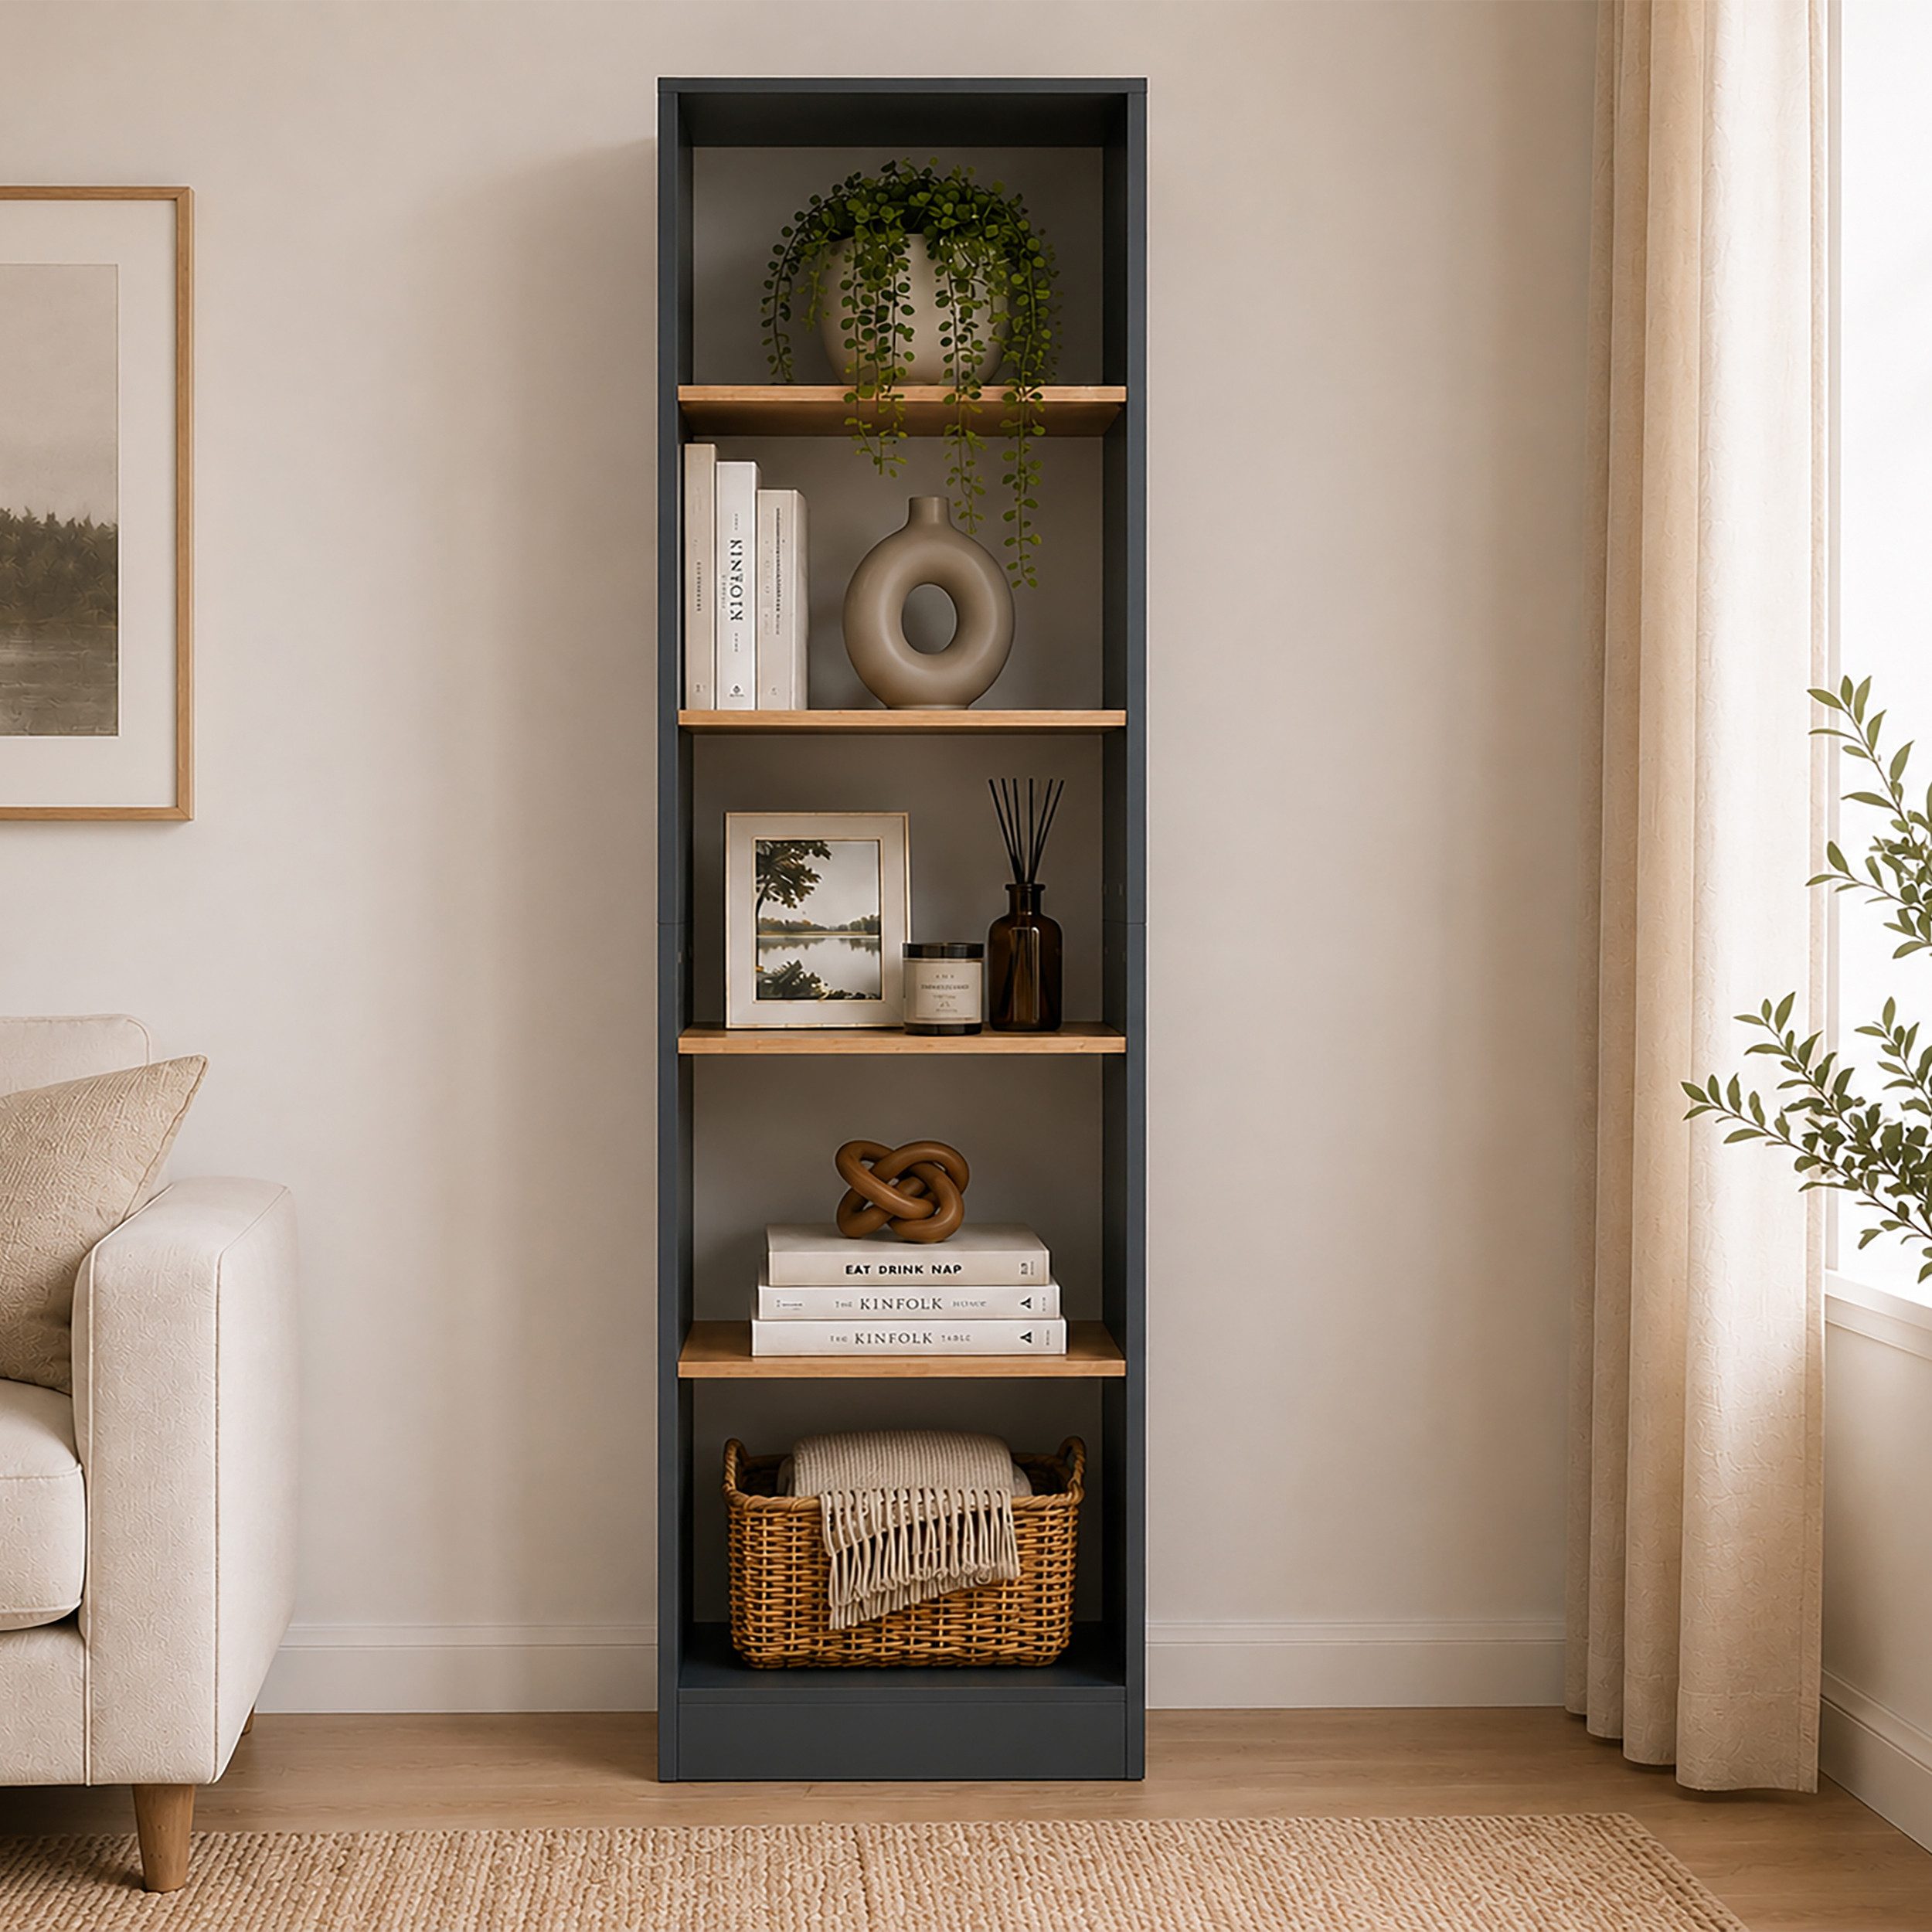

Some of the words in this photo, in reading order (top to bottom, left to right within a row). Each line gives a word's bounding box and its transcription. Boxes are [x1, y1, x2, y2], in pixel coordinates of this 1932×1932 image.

[845, 1264, 871, 1275] EAT
[879, 1264, 923, 1275] DRINK
[931, 1264, 962, 1274] NAP
[860, 1298, 943, 1310] KINFOLK
[855, 1332, 933, 1345] KINFOLK
